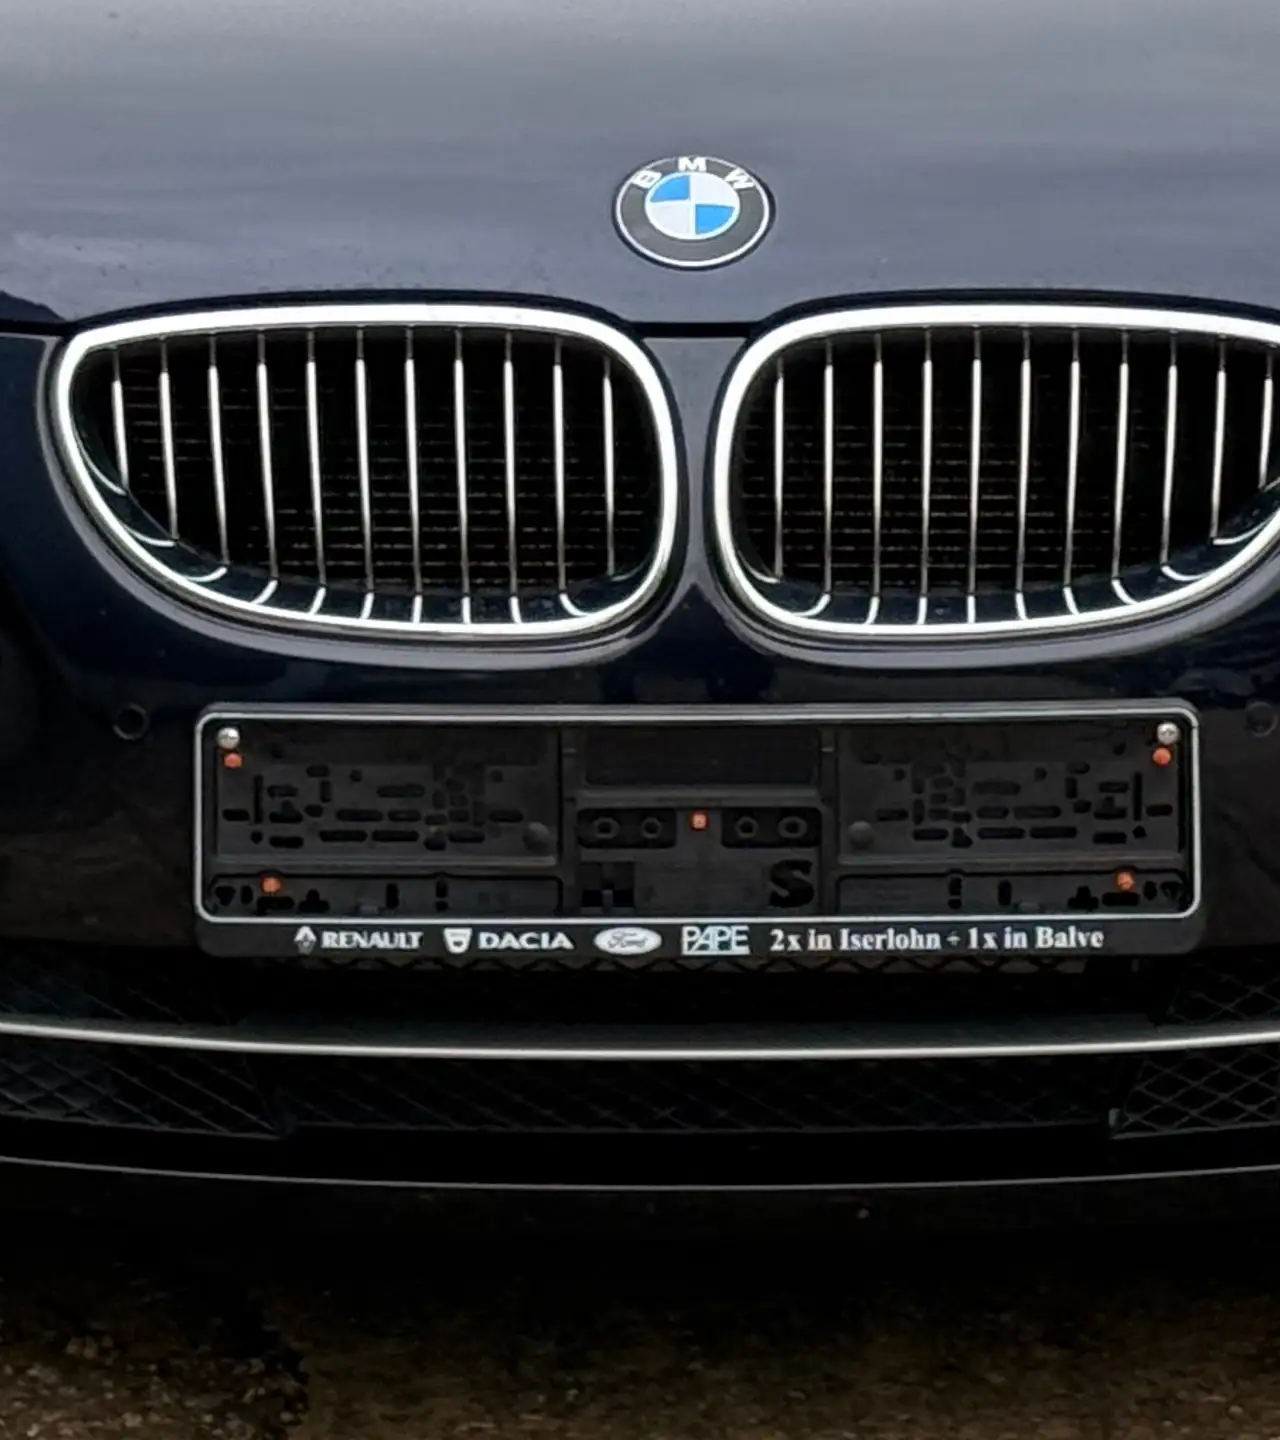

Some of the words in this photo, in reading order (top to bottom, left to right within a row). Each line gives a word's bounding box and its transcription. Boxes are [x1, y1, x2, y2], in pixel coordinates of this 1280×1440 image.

[631, 156, 756, 190] BMW
[321, 930, 424, 950] RENAULT
[478, 931, 575, 950] DACIA
[681, 925, 751, 955] PAPE
[770, 928, 803, 951] 2x
[808, 928, 832, 951] in
[839, 927, 942, 951] Iserlohn
[967, 926, 998, 950] 1x
[1003, 926, 1028, 949] in
[1035, 925, 1105, 949] Balve
